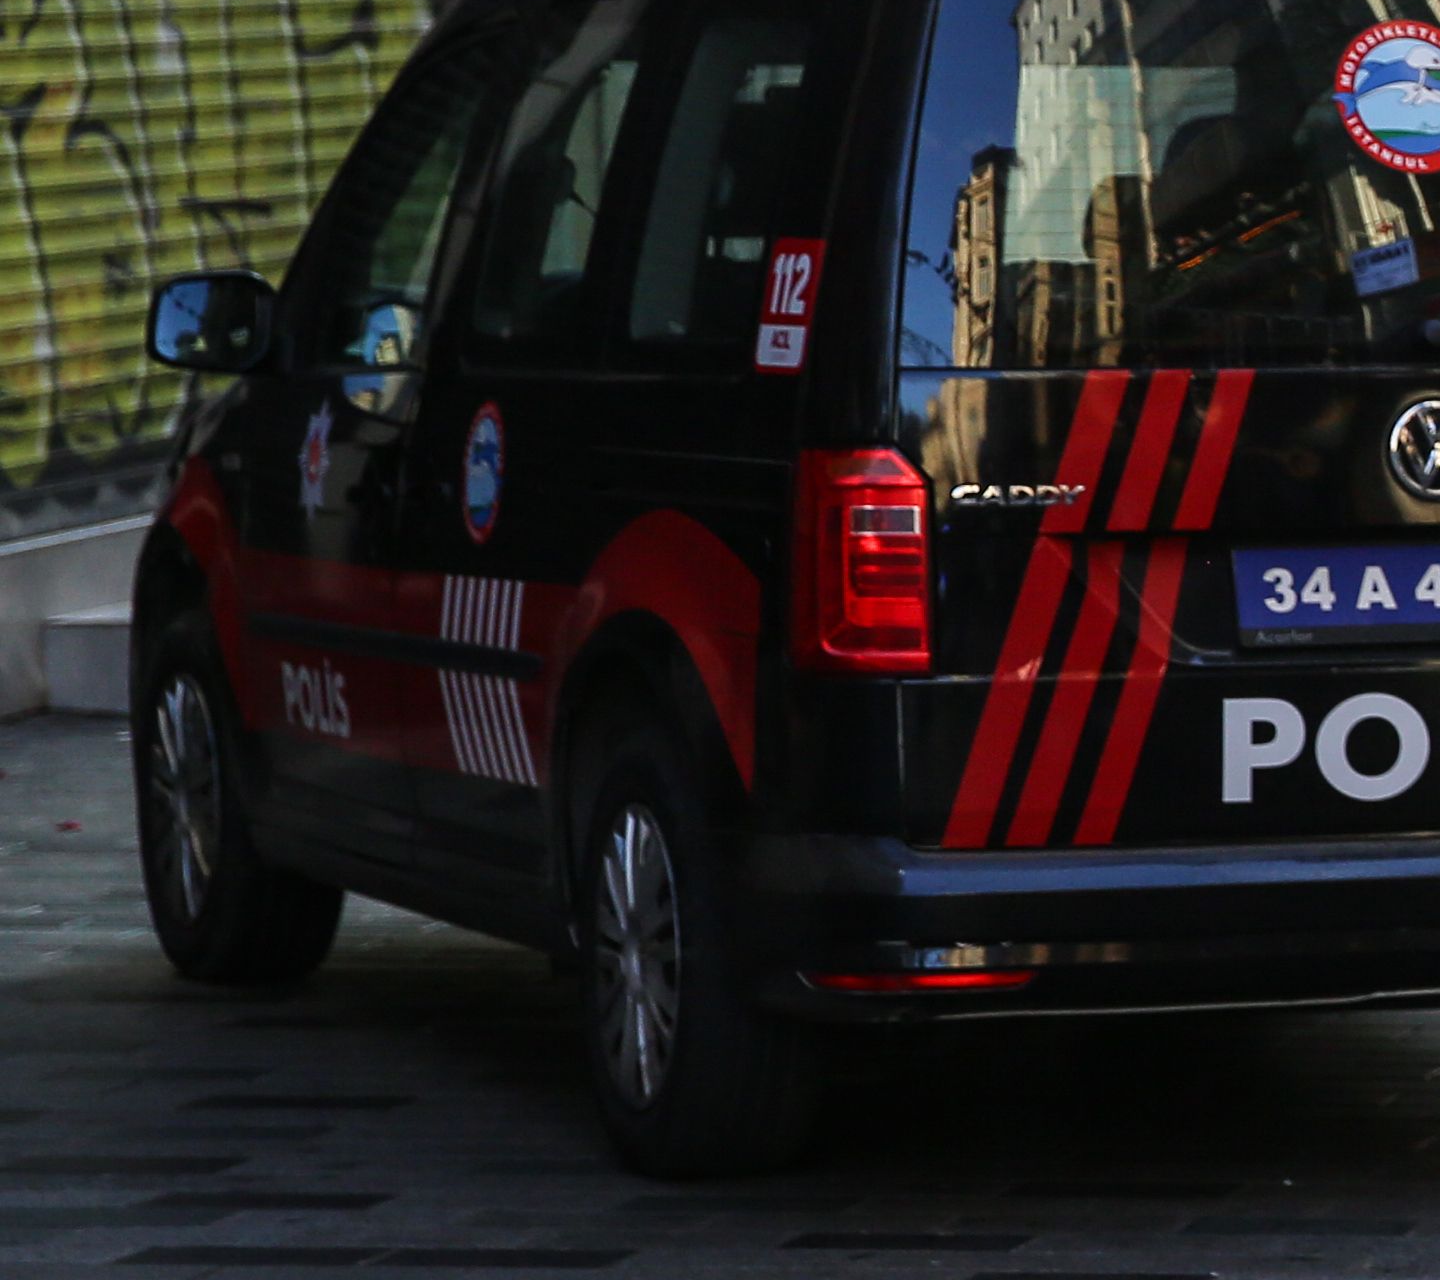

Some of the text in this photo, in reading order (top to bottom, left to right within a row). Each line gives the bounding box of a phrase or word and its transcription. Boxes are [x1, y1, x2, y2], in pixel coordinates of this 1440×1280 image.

[769, 252, 812, 315] 112
[951, 484, 1086, 506] CADDY
[1262, 566, 1337, 614] 34
[1355, 565, 1399, 611] A
